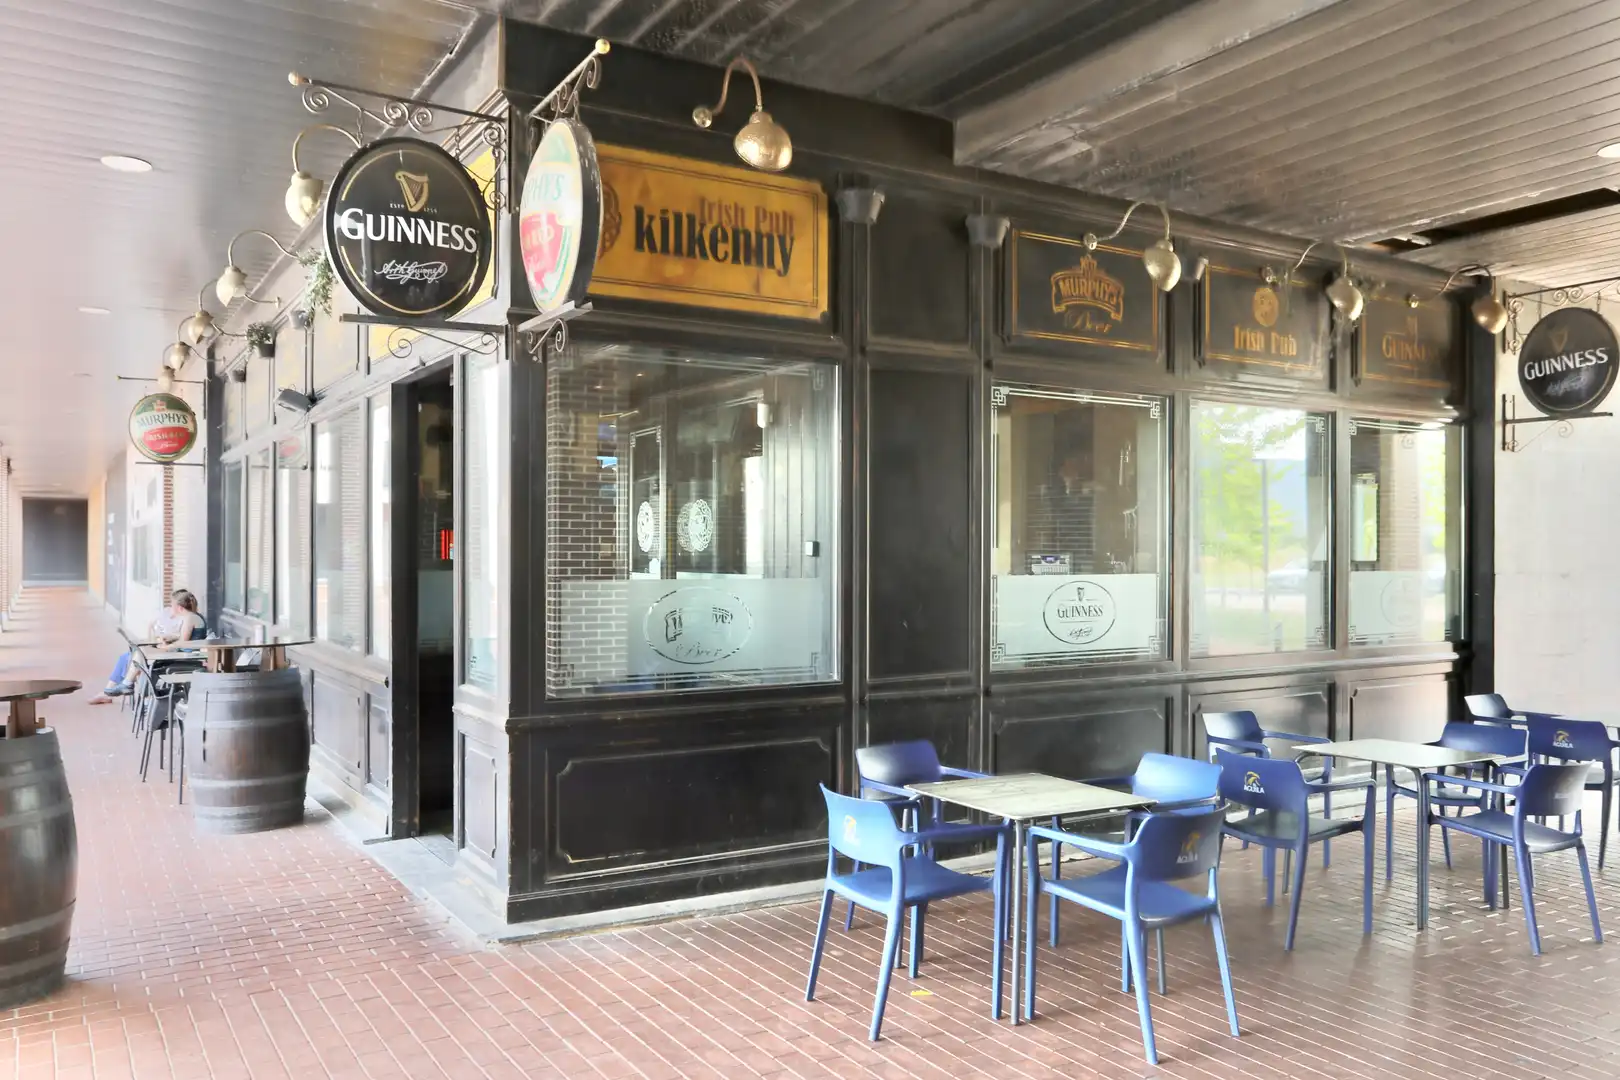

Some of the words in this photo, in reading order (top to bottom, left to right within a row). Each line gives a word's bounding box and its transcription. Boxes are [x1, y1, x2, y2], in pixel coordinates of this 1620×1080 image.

[340, 207, 478, 254] GUINNESS
[699, 196, 746, 229] Irish
[755, 205, 794, 237] Pub
[634, 205, 794, 277] kilkenny
[1234, 325, 1265, 352] Irish
[1271, 332, 1297, 356] Pub
[1524, 347, 1609, 380] GUINNESS
[1057, 603, 1104, 619] GUINNESS
